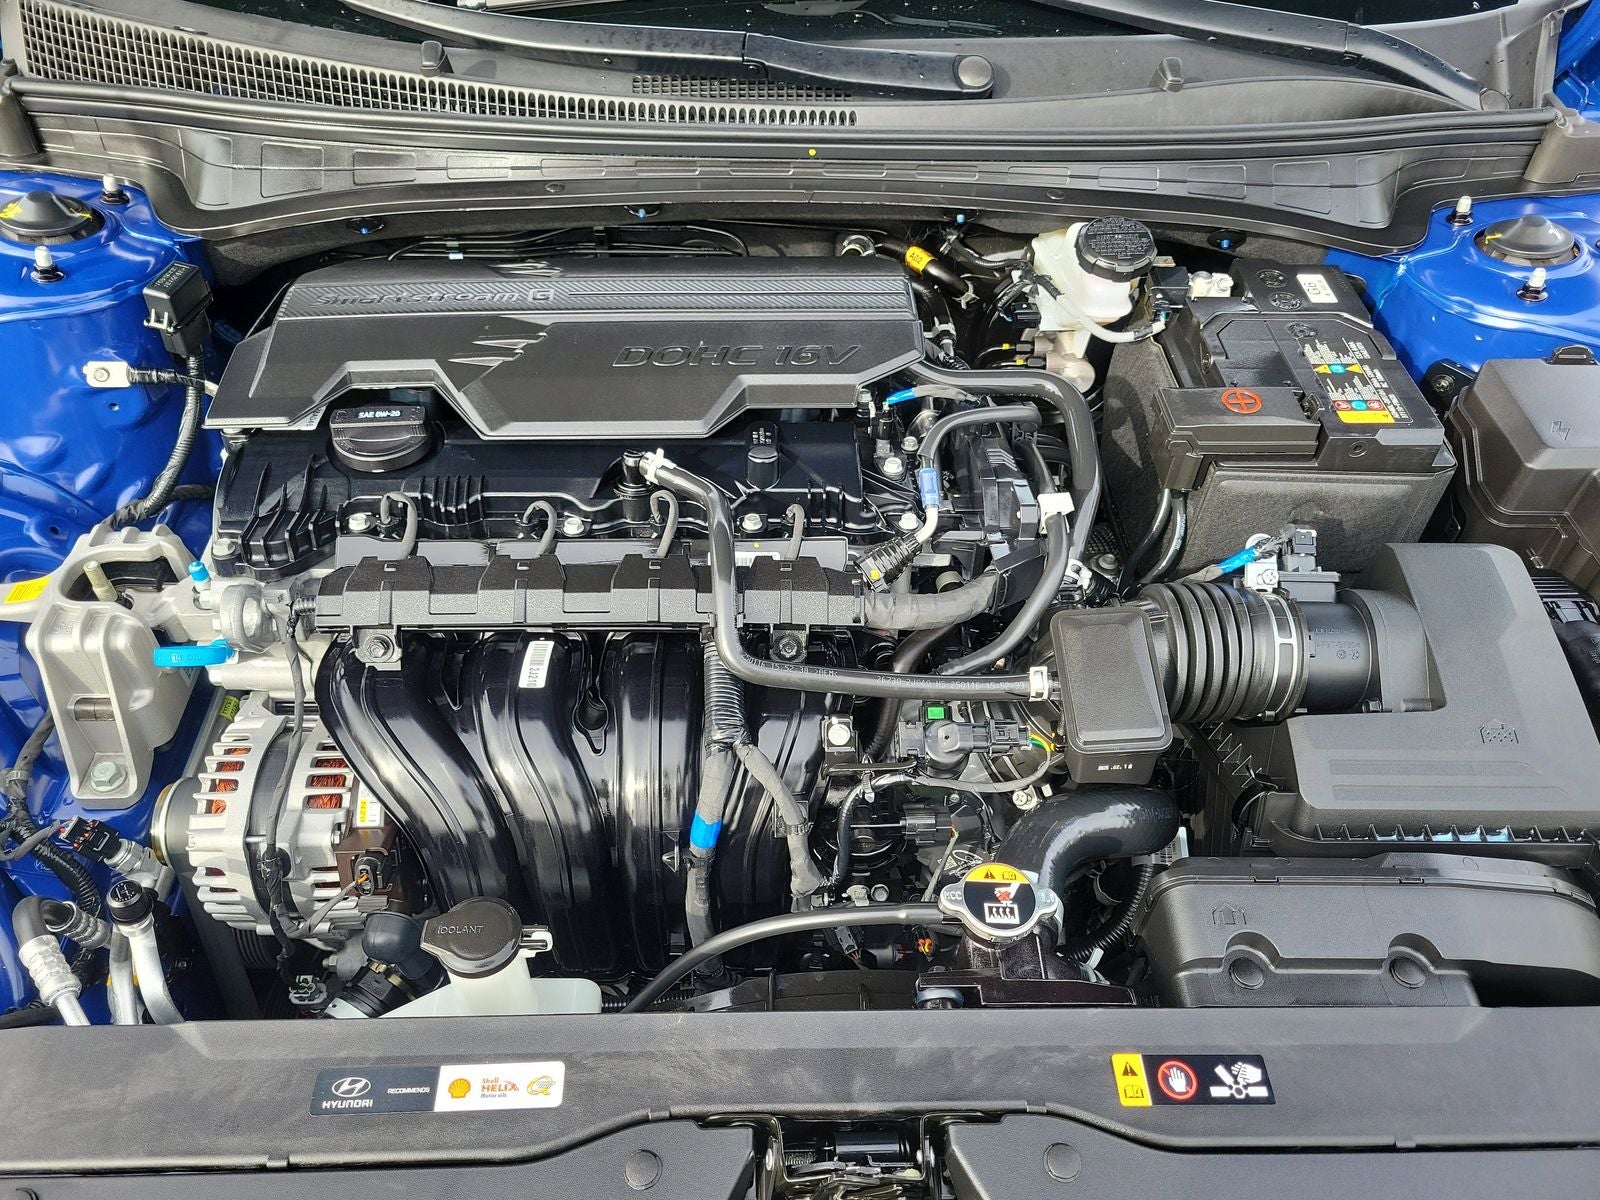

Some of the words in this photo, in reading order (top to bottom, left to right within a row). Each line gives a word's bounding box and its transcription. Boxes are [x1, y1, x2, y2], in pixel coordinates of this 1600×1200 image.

[315, 290, 519, 306] Smartstream
[612, 345, 764, 367] DOHC
[775, 345, 862, 366] 16V
[358, 411, 375, 419] SAE
[375, 410, 401, 418] 0W-20
[482, 1077, 499, 1085] Shell
[387, 1086, 431, 1095] RECOMMENDS
[481, 1080, 520, 1093] HELIX
[322, 1099, 374, 1109] HYUNDAI
